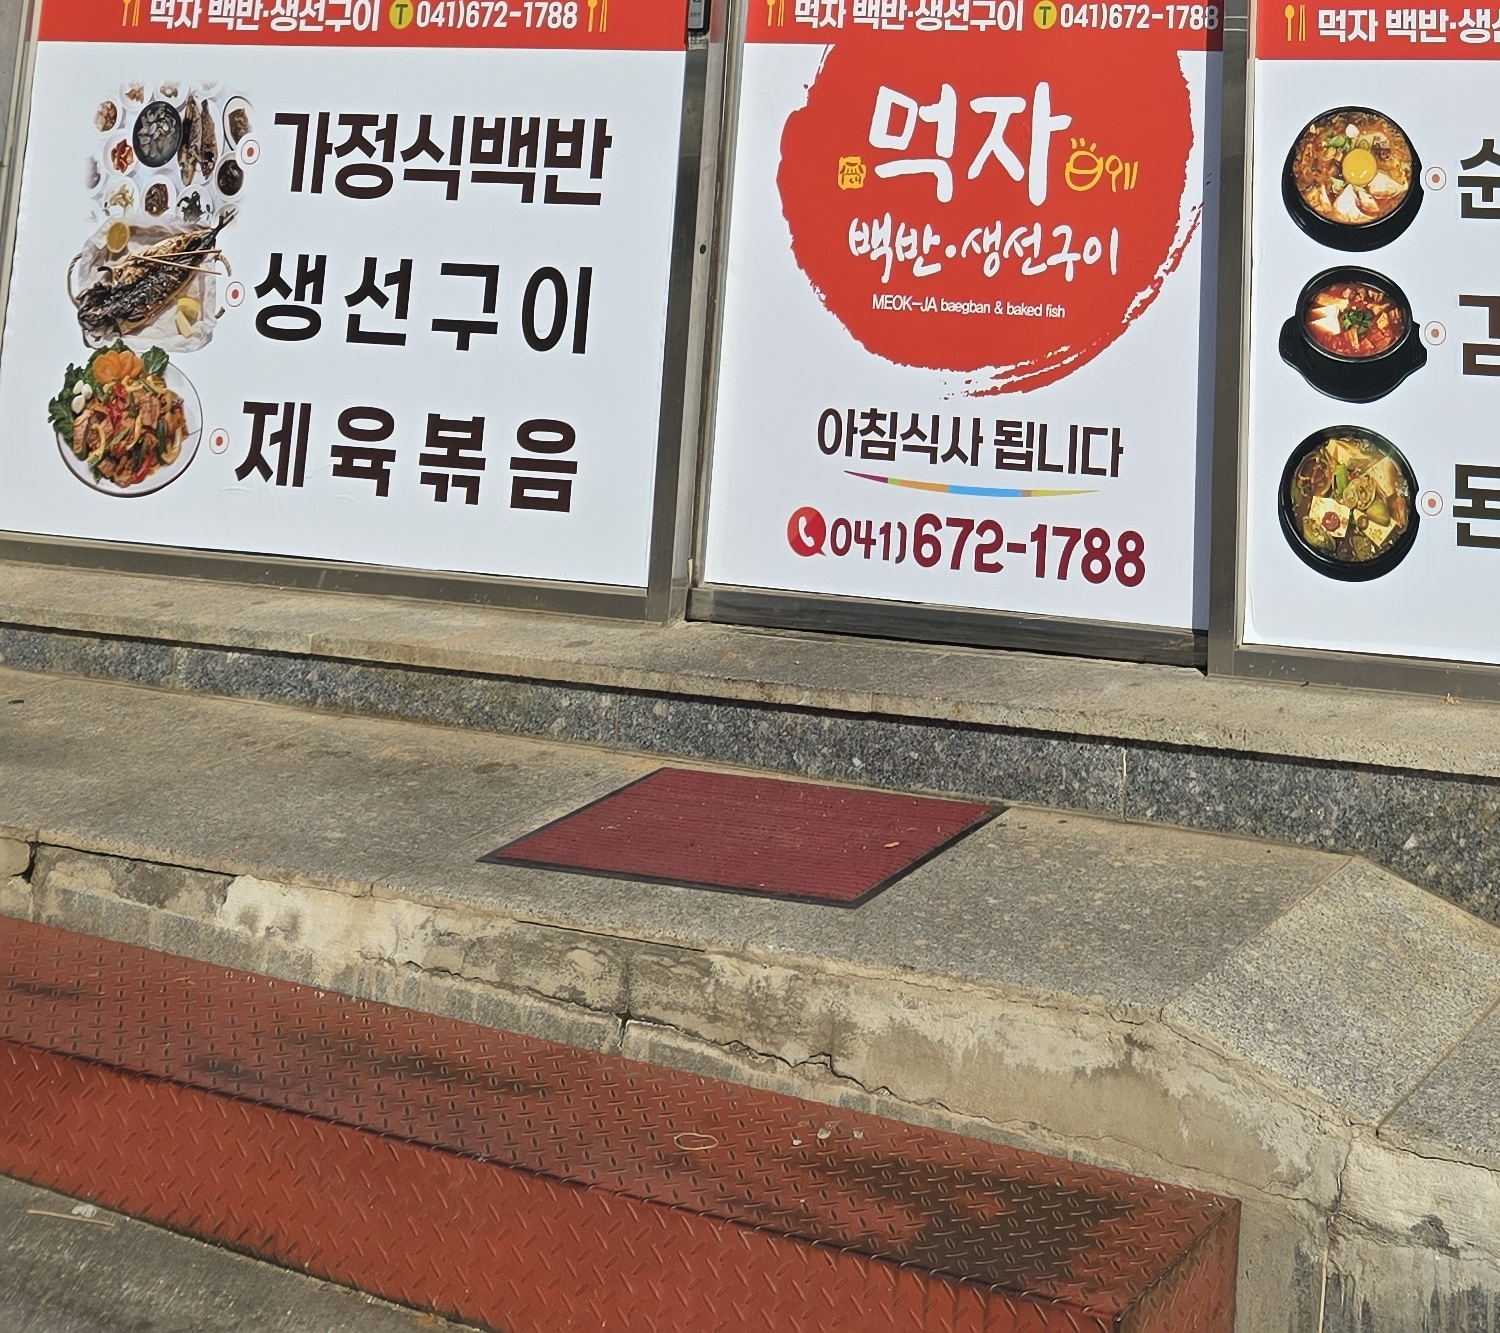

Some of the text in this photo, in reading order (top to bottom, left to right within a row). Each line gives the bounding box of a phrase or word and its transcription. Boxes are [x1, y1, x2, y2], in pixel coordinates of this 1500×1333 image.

[416, 0, 578, 29] 041)672-1788
[1060, 3, 1219, 31] 041)672-1788
[1318, 8, 1379, 43] 먹자
[274, 111, 613, 206] 가정식백반
[868, 81, 1072, 207] 먹자
[253, 252, 593, 355] 생선구이
[872, 293, 1066, 319] MEOK-JA baegban & baked fish
[234, 400, 578, 513] 제육볶음
[817, 407, 1124, 478] 아침식사 됩니다
[829, 512, 1146, 588] 041)672-1788
